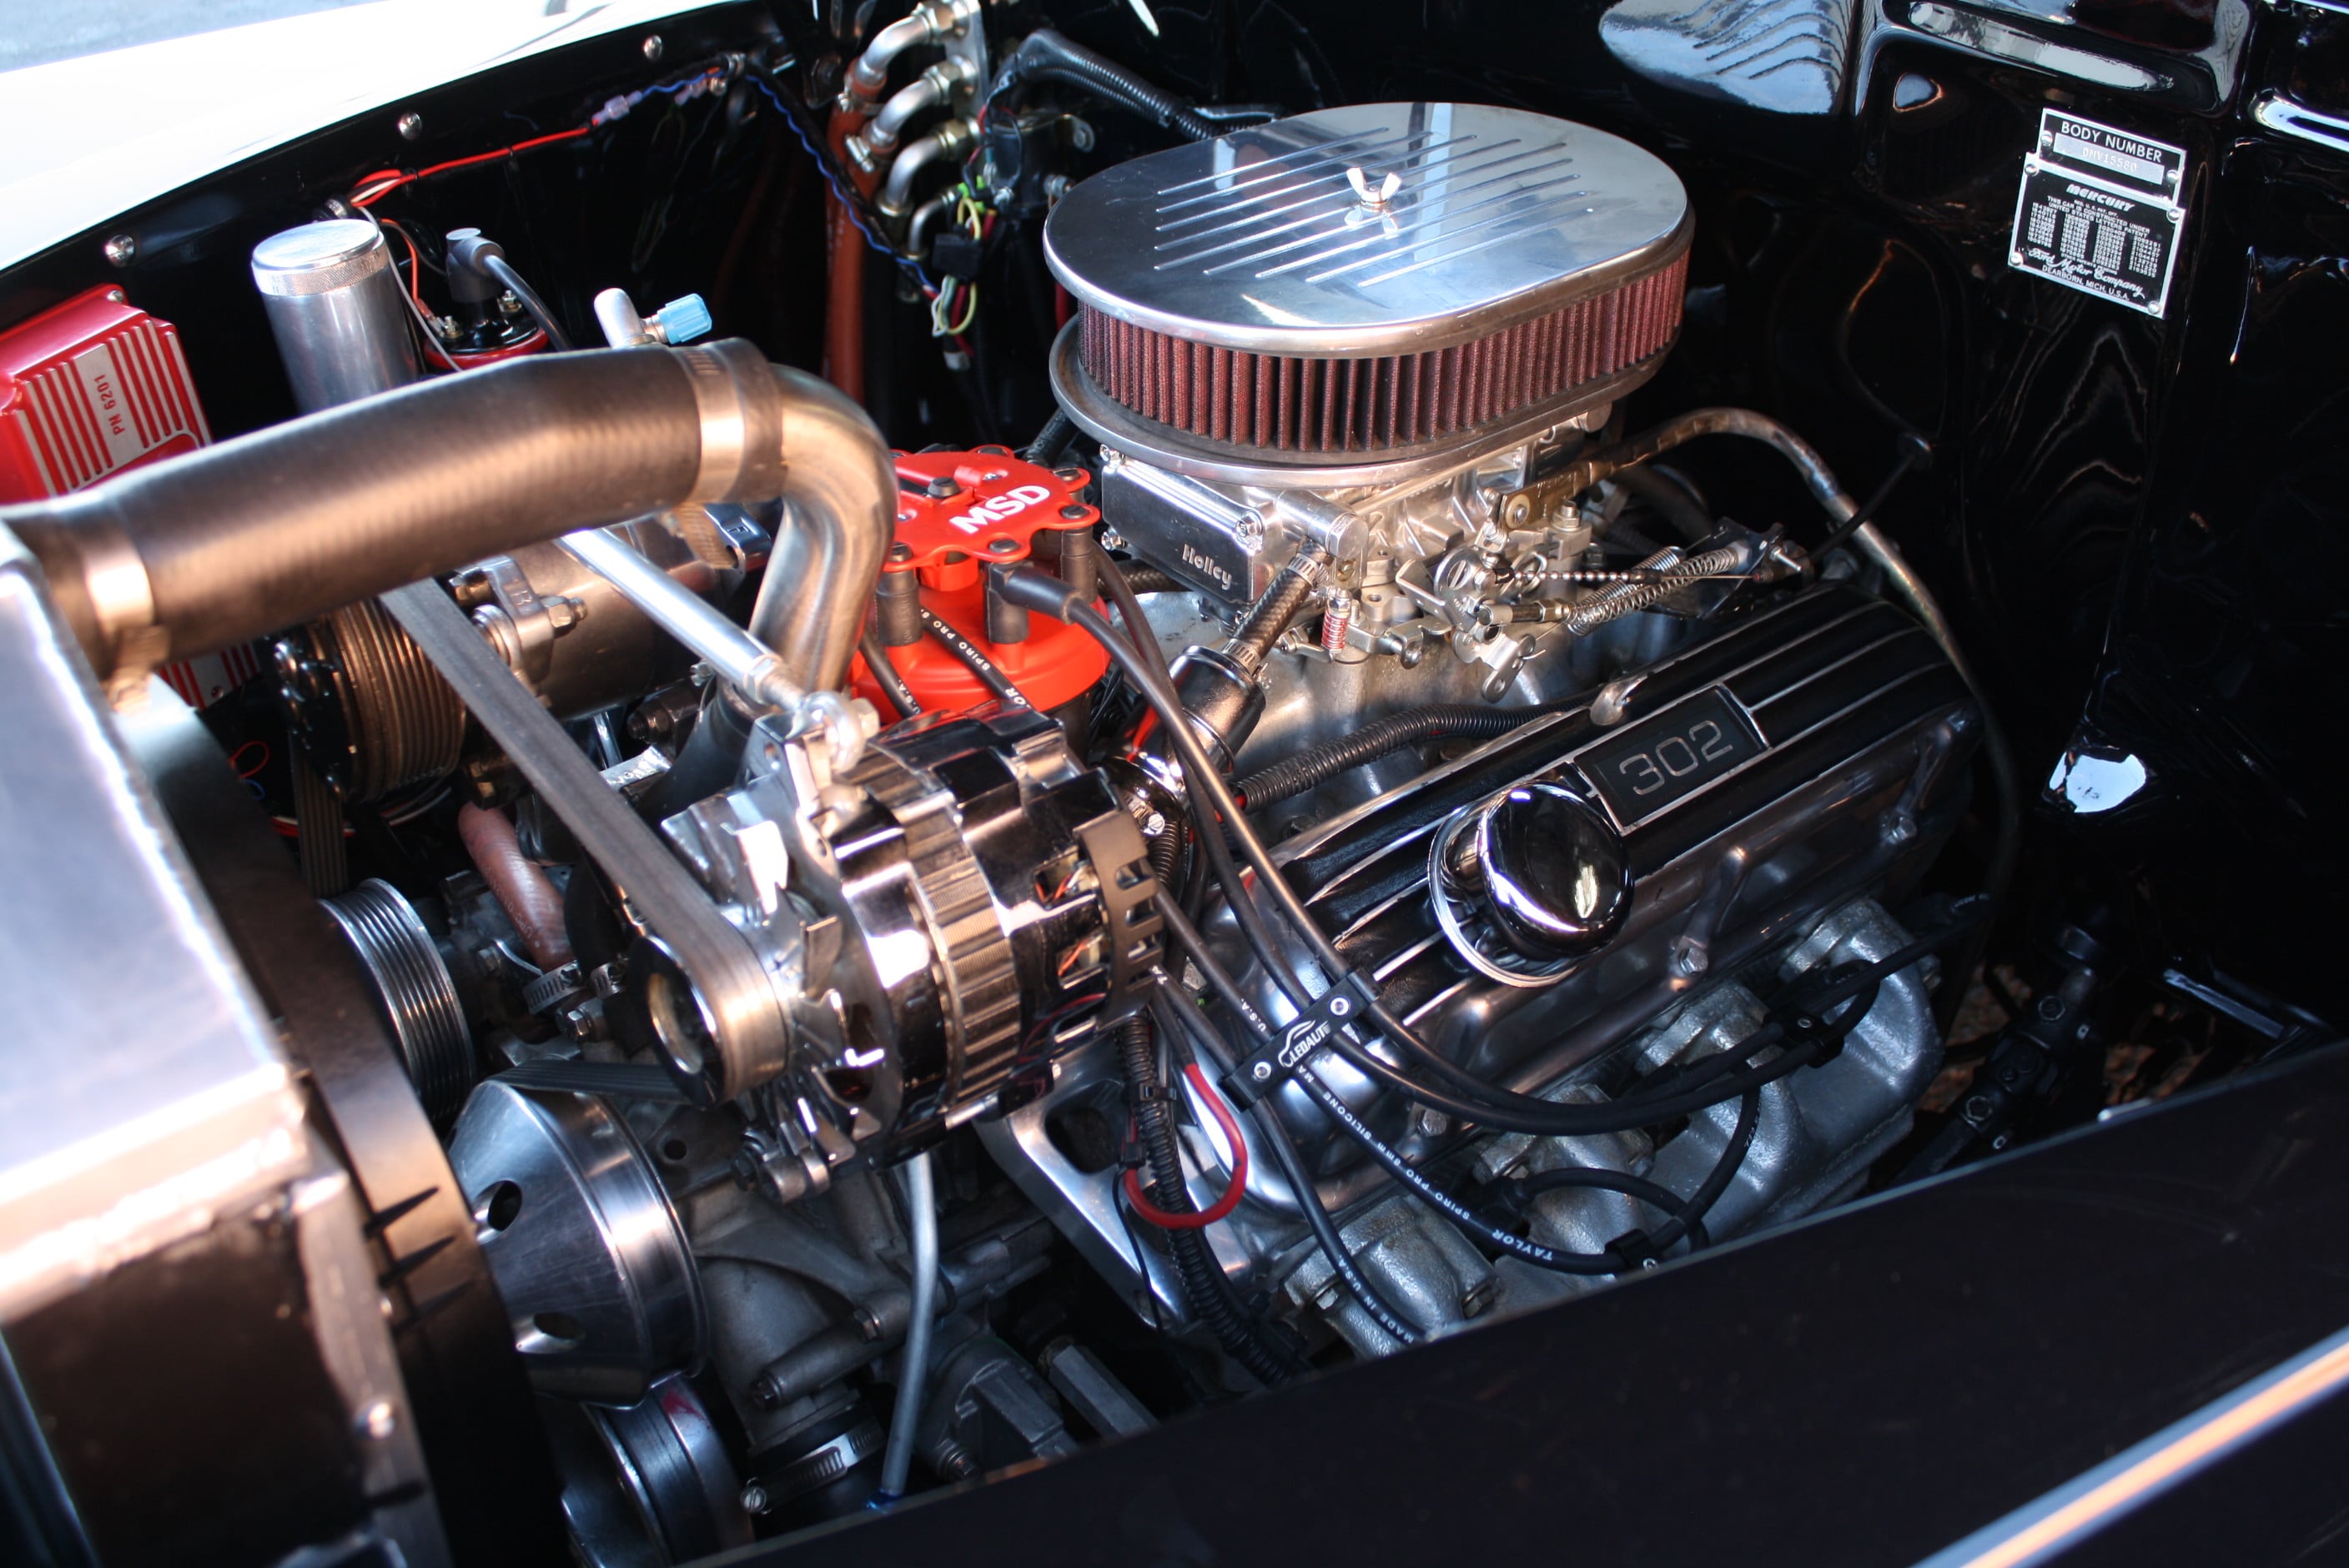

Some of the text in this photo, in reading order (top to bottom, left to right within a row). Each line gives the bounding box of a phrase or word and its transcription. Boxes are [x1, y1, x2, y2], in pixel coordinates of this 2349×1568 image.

[2061, 121, 2162, 163] BODY NUMBER
[2047, 194, 2061, 204] THIS
[2062, 200, 2075, 209] CAR
[2083, 207, 2127, 227] CONSTRUCTED
[2128, 222, 2150, 234] UNDER
[2065, 183, 2135, 212] MERCURY
[2048, 201, 2070, 214] UNITED
[2071, 209, 2094, 221] STATES
[2095, 217, 2123, 231] LETTERS
[2124, 226, 2146, 239] PATENT
[2028, 245, 2055, 264] Ford
[2053, 254, 2093, 280] Motor
[2092, 269, 2147, 299] Company
[93, 374, 125, 435] PN 6201
[948, 485, 1050, 534] MSD
[1182, 543, 1232, 591] Holley
[920, 609, 930, 619] 8
[933, 621, 956, 640] PRO
[959, 641, 990, 671] SPIRO
[1005, 687, 1031, 709] OR
[1619, 720, 1733, 795] 302
[1298, 1064, 1315, 1083] MA
[1322, 1091, 1372, 1141] SILICONE
[1377, 1141, 1401, 1167] 8mm
[1406, 1169, 1430, 1191] PRO
[1435, 1192, 1471, 1221] SPIRO
[1491, 1228, 1553, 1261] TAYLOR
[1338, 1254, 1414, 1344] MADE IN U.S.A.
